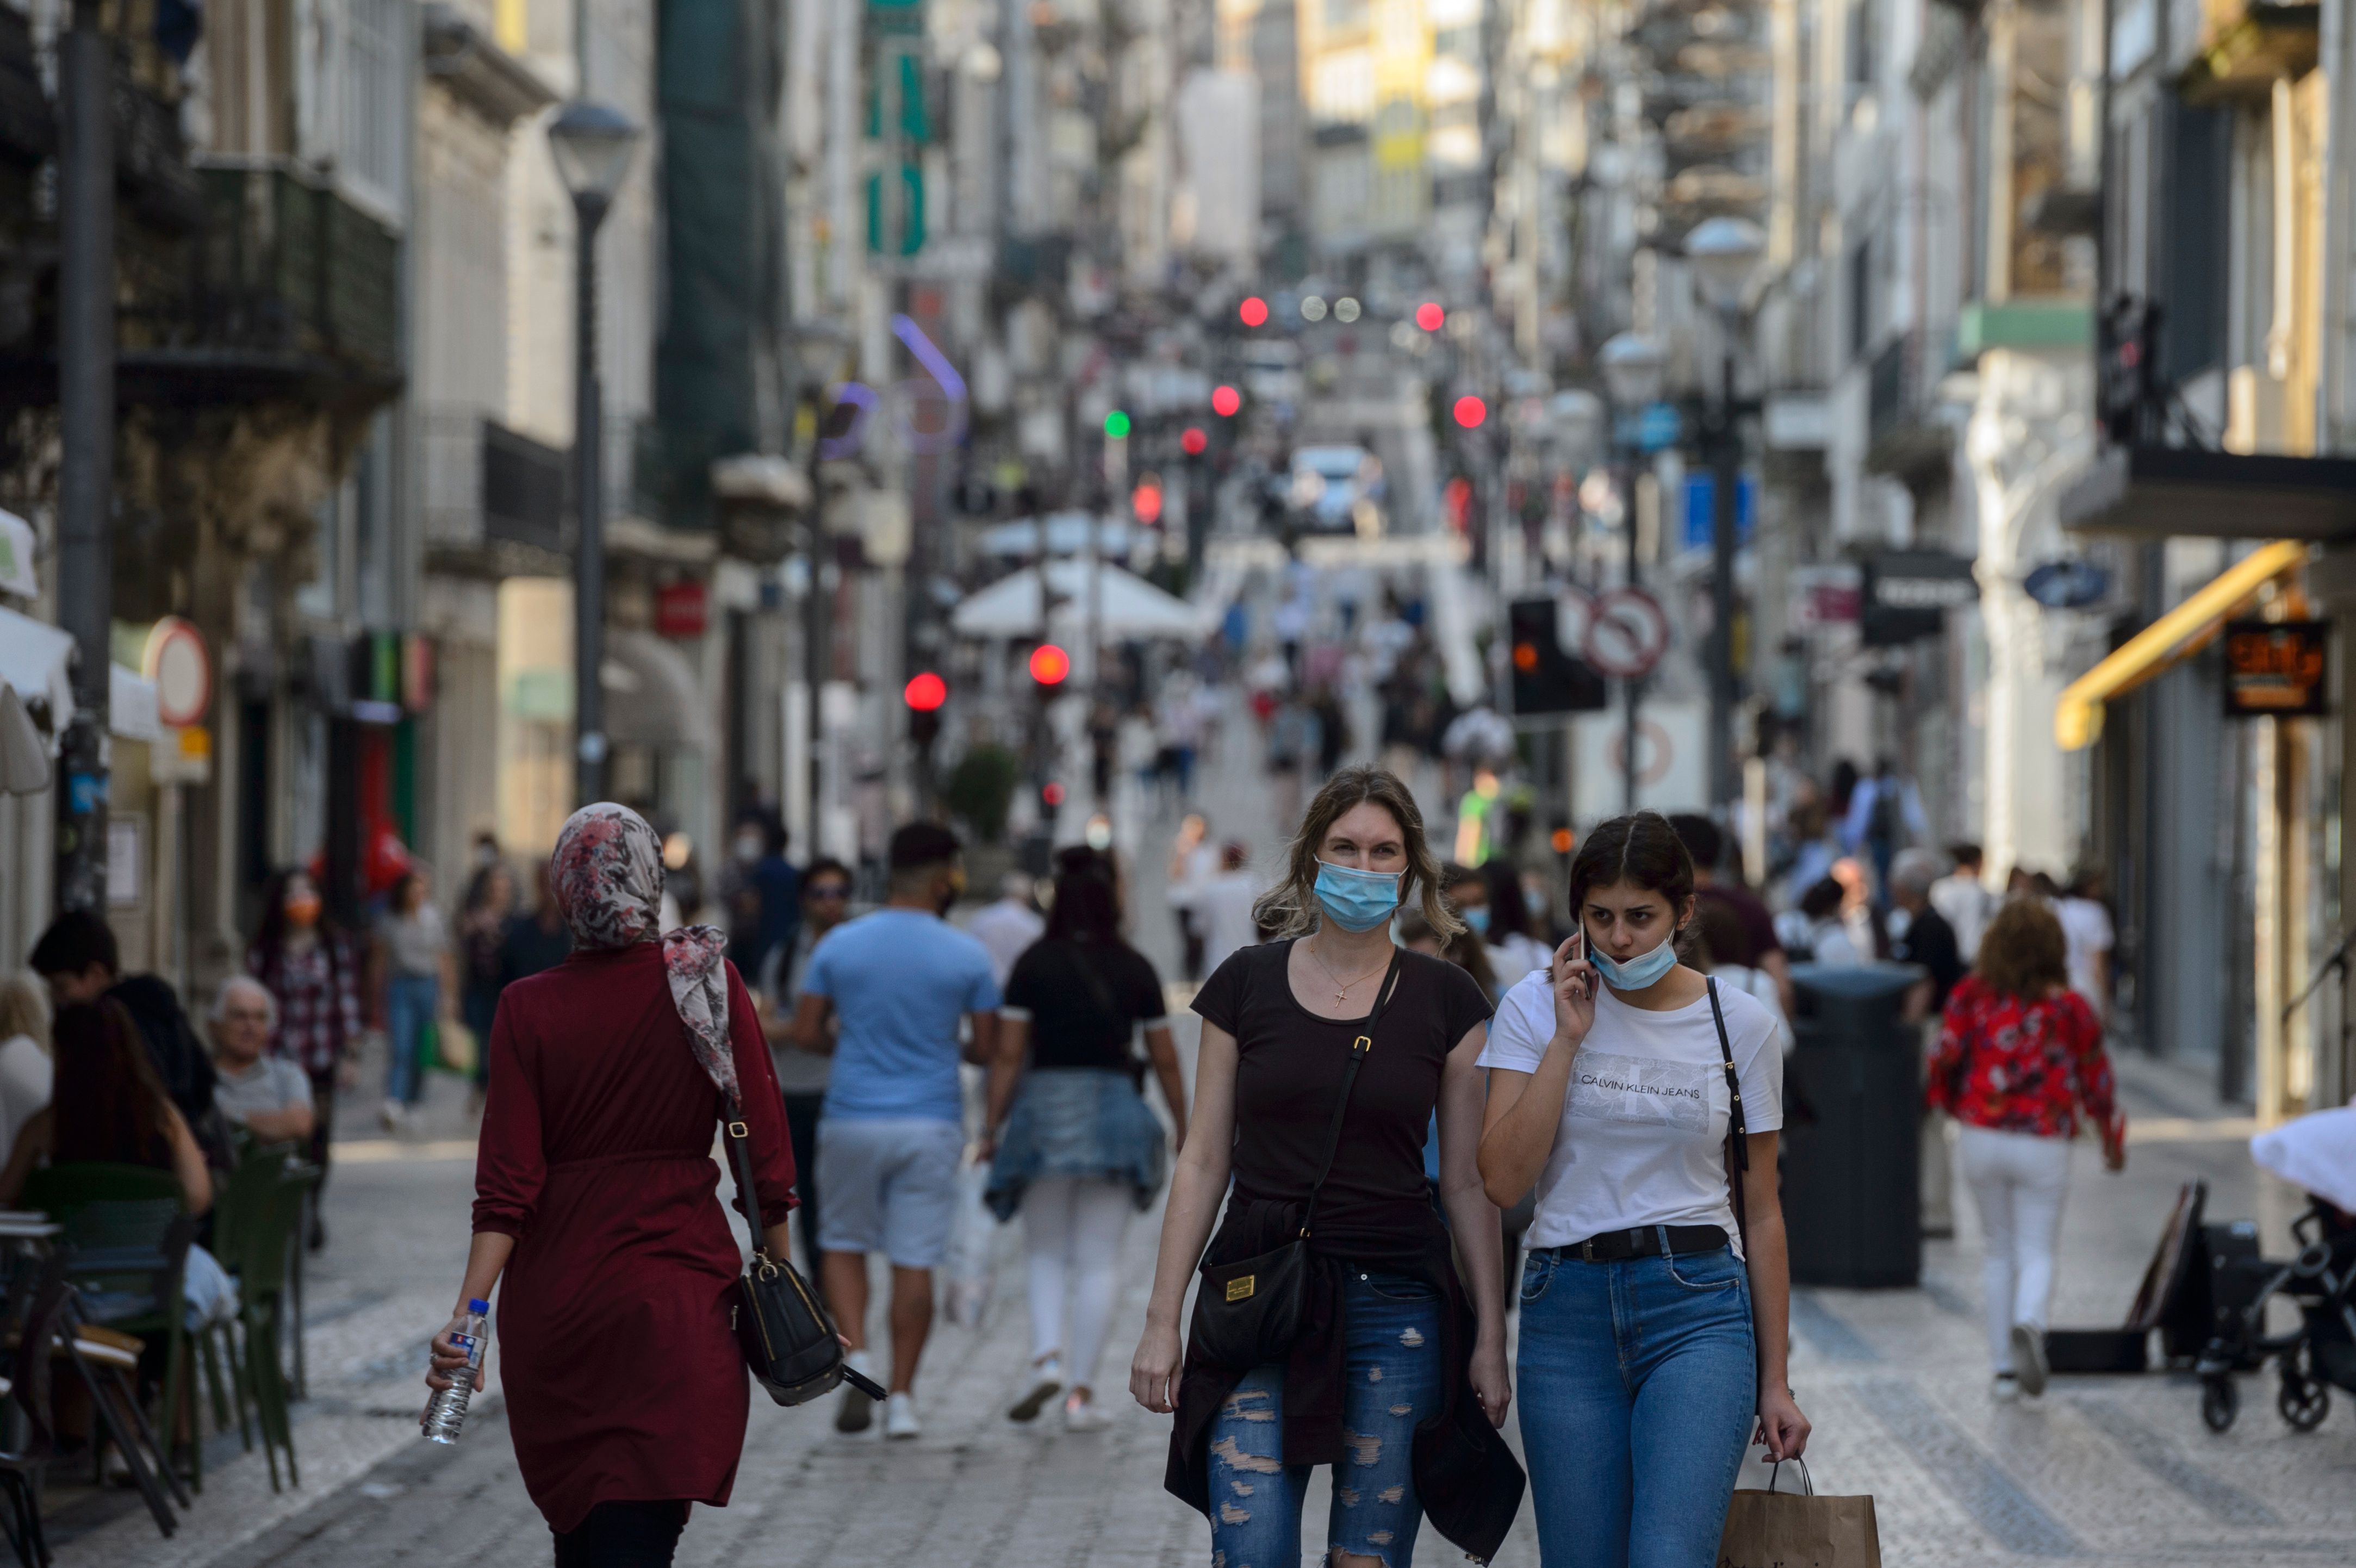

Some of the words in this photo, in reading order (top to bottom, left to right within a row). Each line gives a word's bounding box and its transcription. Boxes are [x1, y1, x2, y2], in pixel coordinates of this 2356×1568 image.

[1581, 1074, 1624, 1090] CALVIN
[1626, 1084, 1659, 1095] KLEIN
[1662, 1087, 1700, 1099] JEANS
